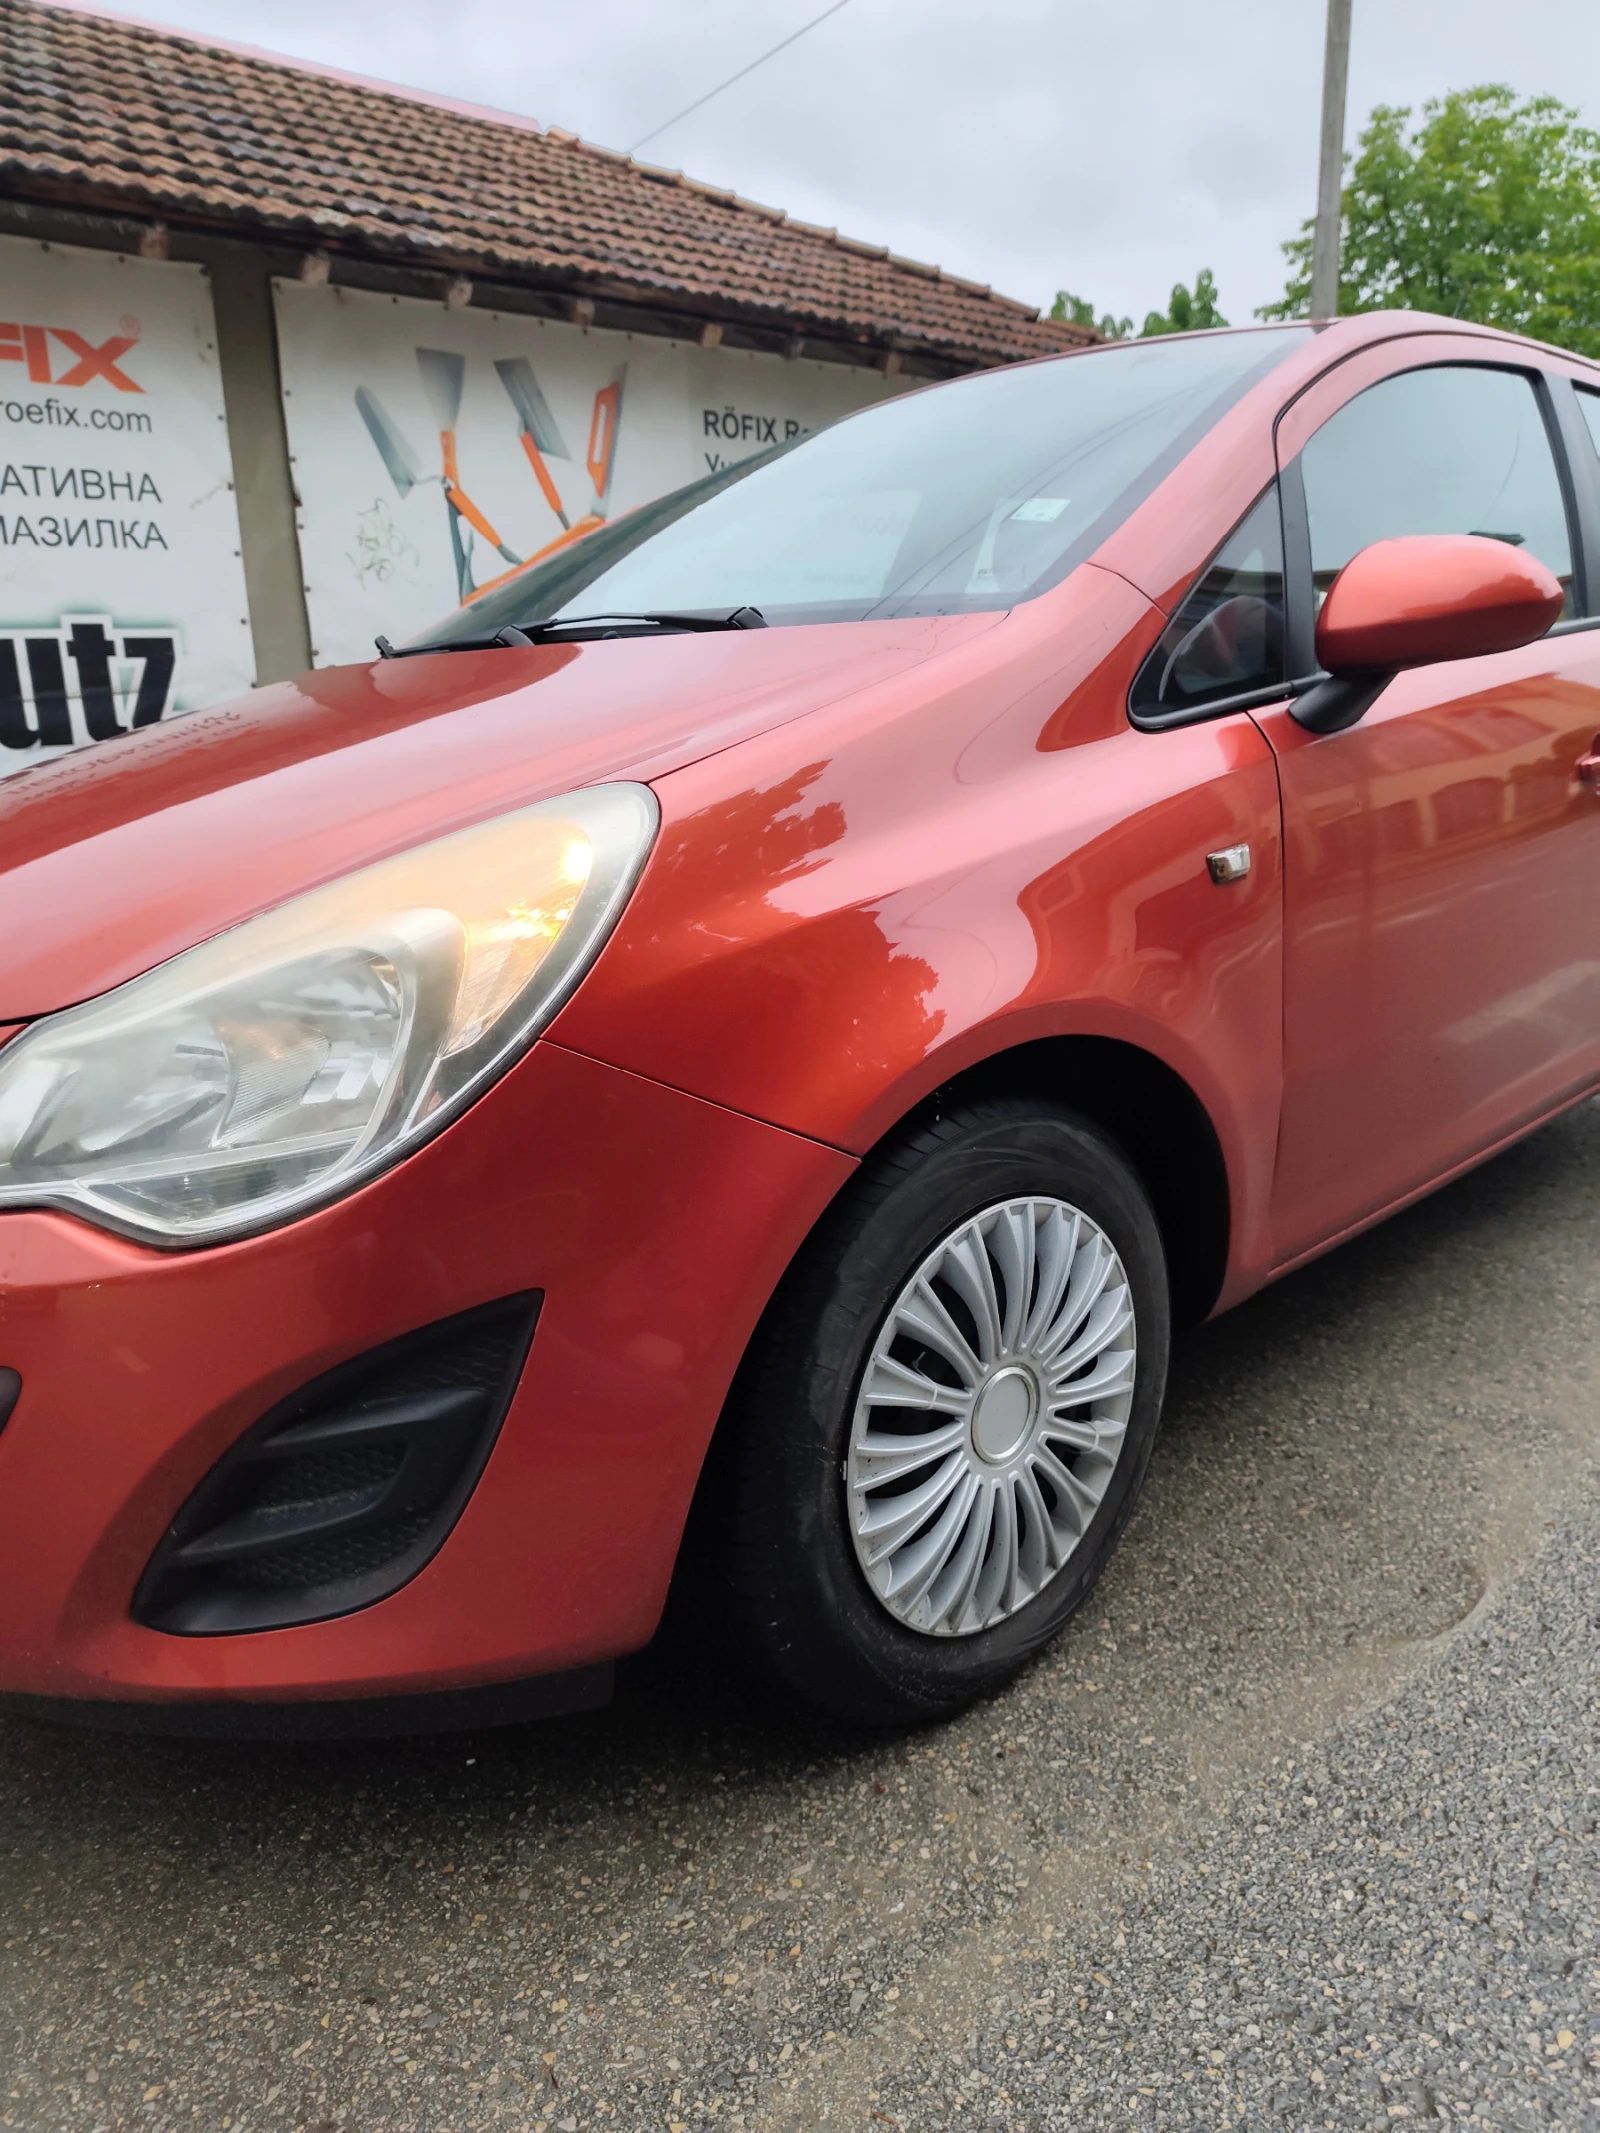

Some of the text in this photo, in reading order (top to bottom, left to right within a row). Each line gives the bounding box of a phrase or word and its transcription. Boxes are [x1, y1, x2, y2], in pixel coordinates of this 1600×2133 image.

[0, 398, 152, 433] oefix.com
[703, 406, 777, 443] RÖFIX
[0, 464, 162, 503] АТИВНА
